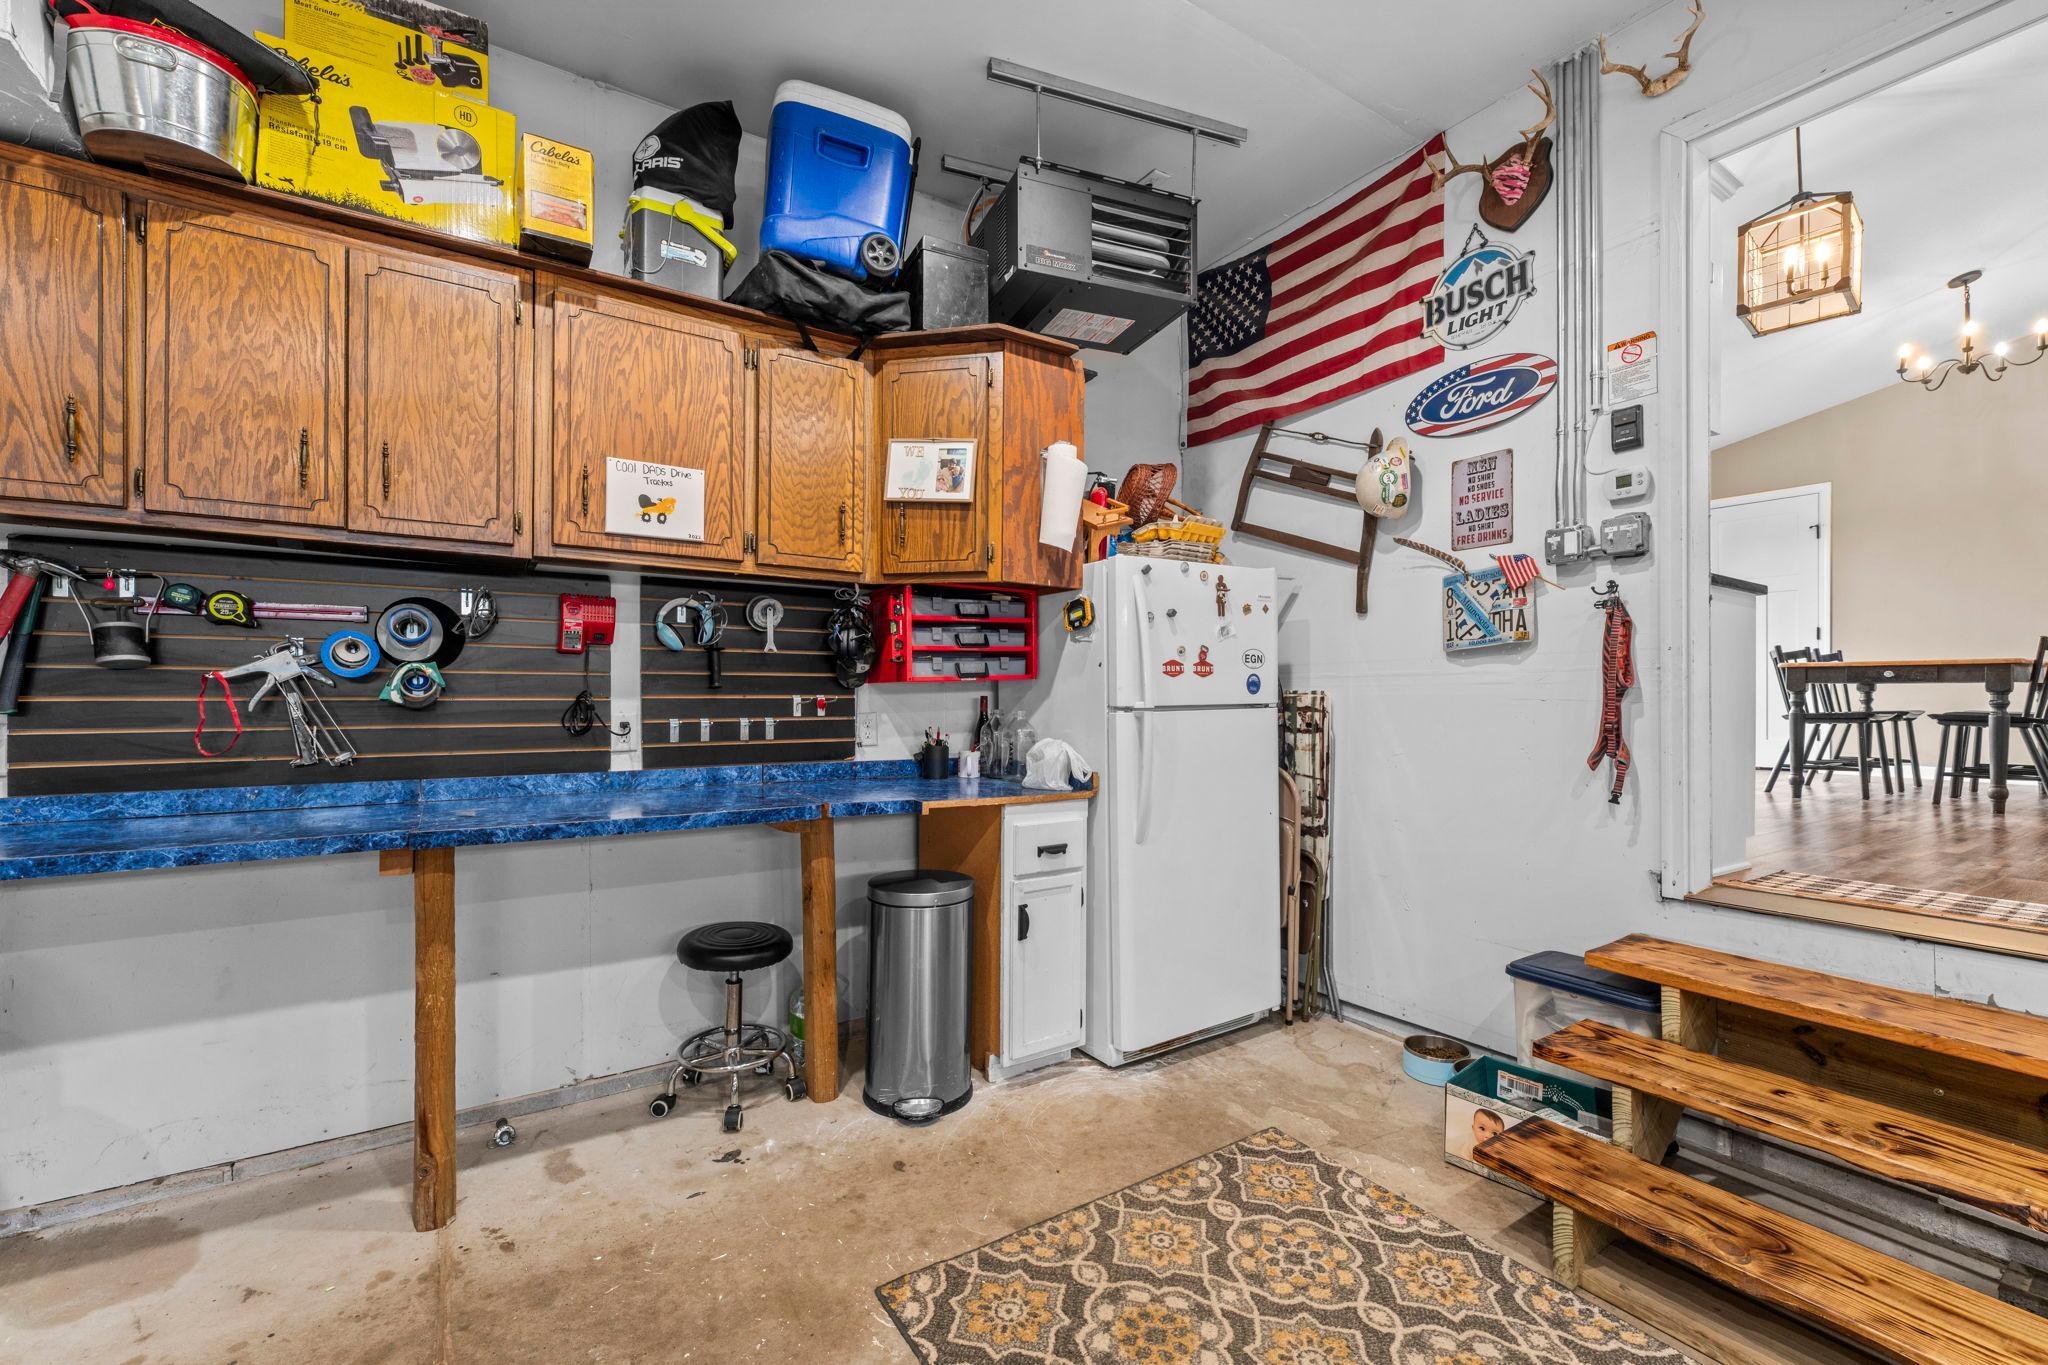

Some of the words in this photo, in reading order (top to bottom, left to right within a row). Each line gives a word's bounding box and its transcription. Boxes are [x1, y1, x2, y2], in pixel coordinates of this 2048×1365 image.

[459, 110, 472, 122] HD
[530, 140, 580, 166] Cabela's
[1424, 261, 1530, 328] BUSCH
[1447, 300, 1508, 336] LIGHT
[1439, 377, 1516, 420] Ford
[904, 446, 925, 457] WE
[1467, 456, 1498, 475] MEN
[670, 468, 692, 479] Drive
[1468, 476, 1476, 484] NO
[1477, 472, 1495, 483] SHIRT
[643, 476, 673, 487] Tractors
[1467, 484, 1476, 493] NO
[1477, 481, 1495, 491] SHOES
[898, 487, 925, 499] YOU
[1459, 495, 1470, 506] NO
[1472, 488, 1504, 503] SERVICE
[1455, 503, 1510, 526] LADIES
[1468, 524, 1476, 532] NO
[1477, 521, 1495, 531] SHIRT
[1457, 533, 1476, 546] FREE
[1477, 528, 1508, 543] DRINKS
[1244, 654, 1263, 664] EGN
